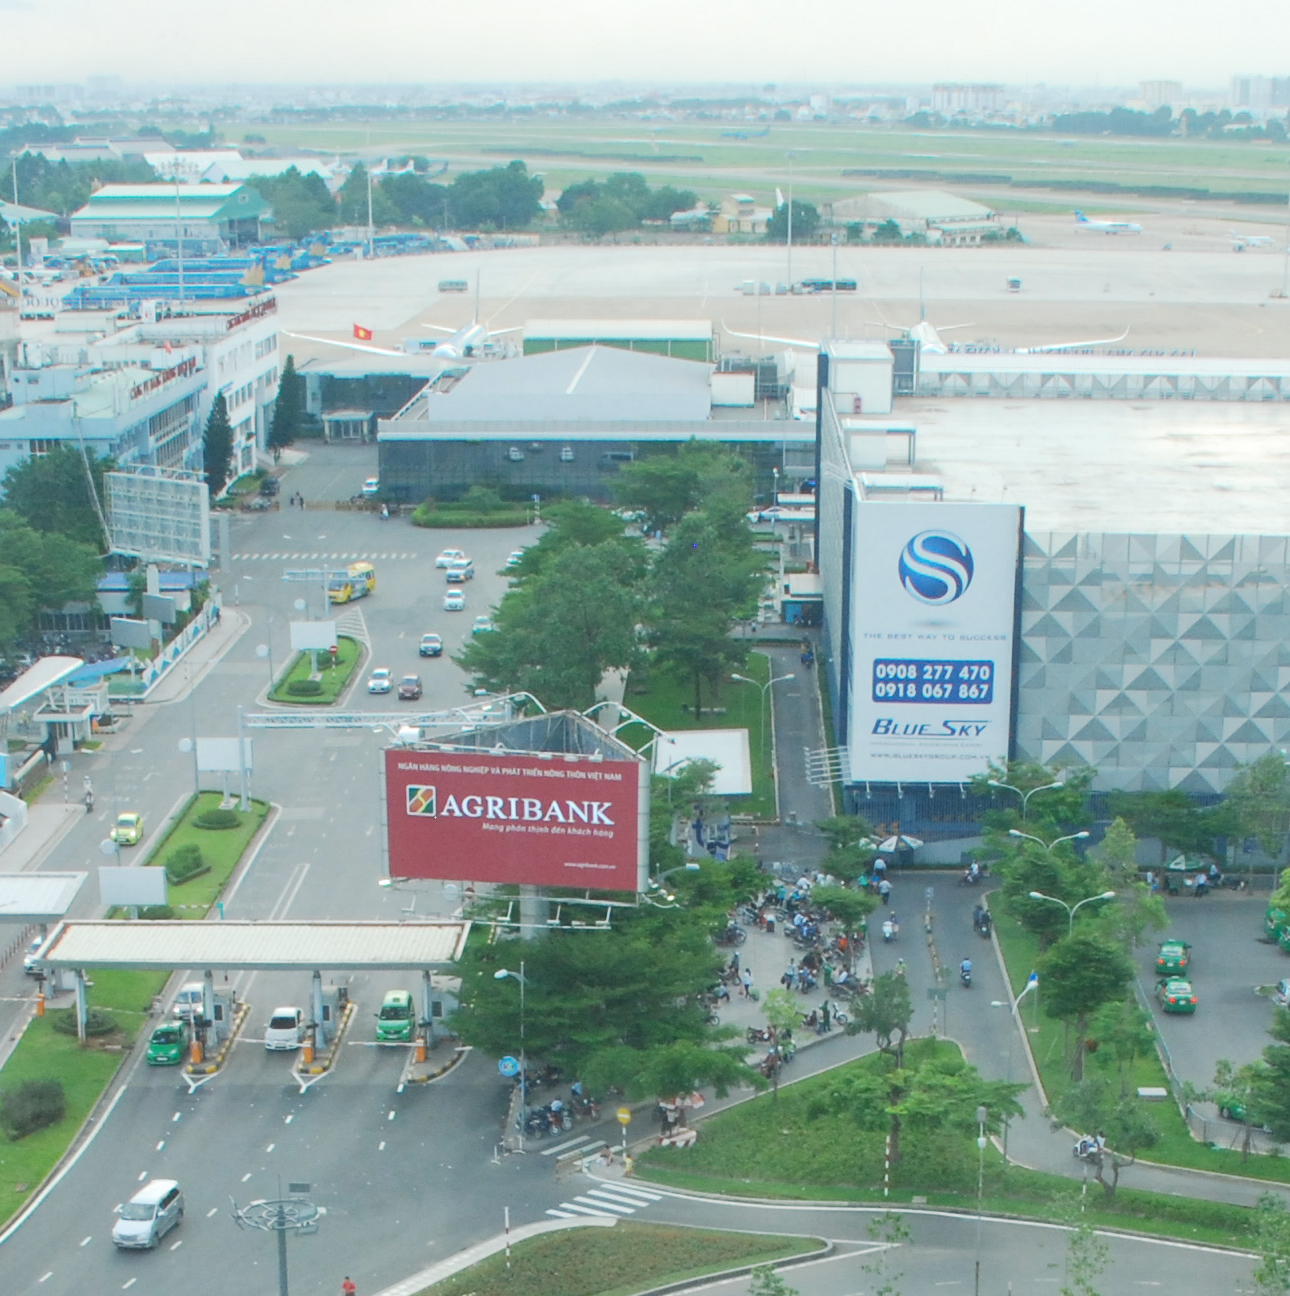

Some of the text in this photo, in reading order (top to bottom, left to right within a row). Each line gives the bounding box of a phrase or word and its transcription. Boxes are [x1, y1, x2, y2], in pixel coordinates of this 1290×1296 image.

[875, 663, 990, 681] 0908 277 470
[875, 682, 989, 699] 0918 067 867
[441, 794, 615, 826] AGRIBANK
